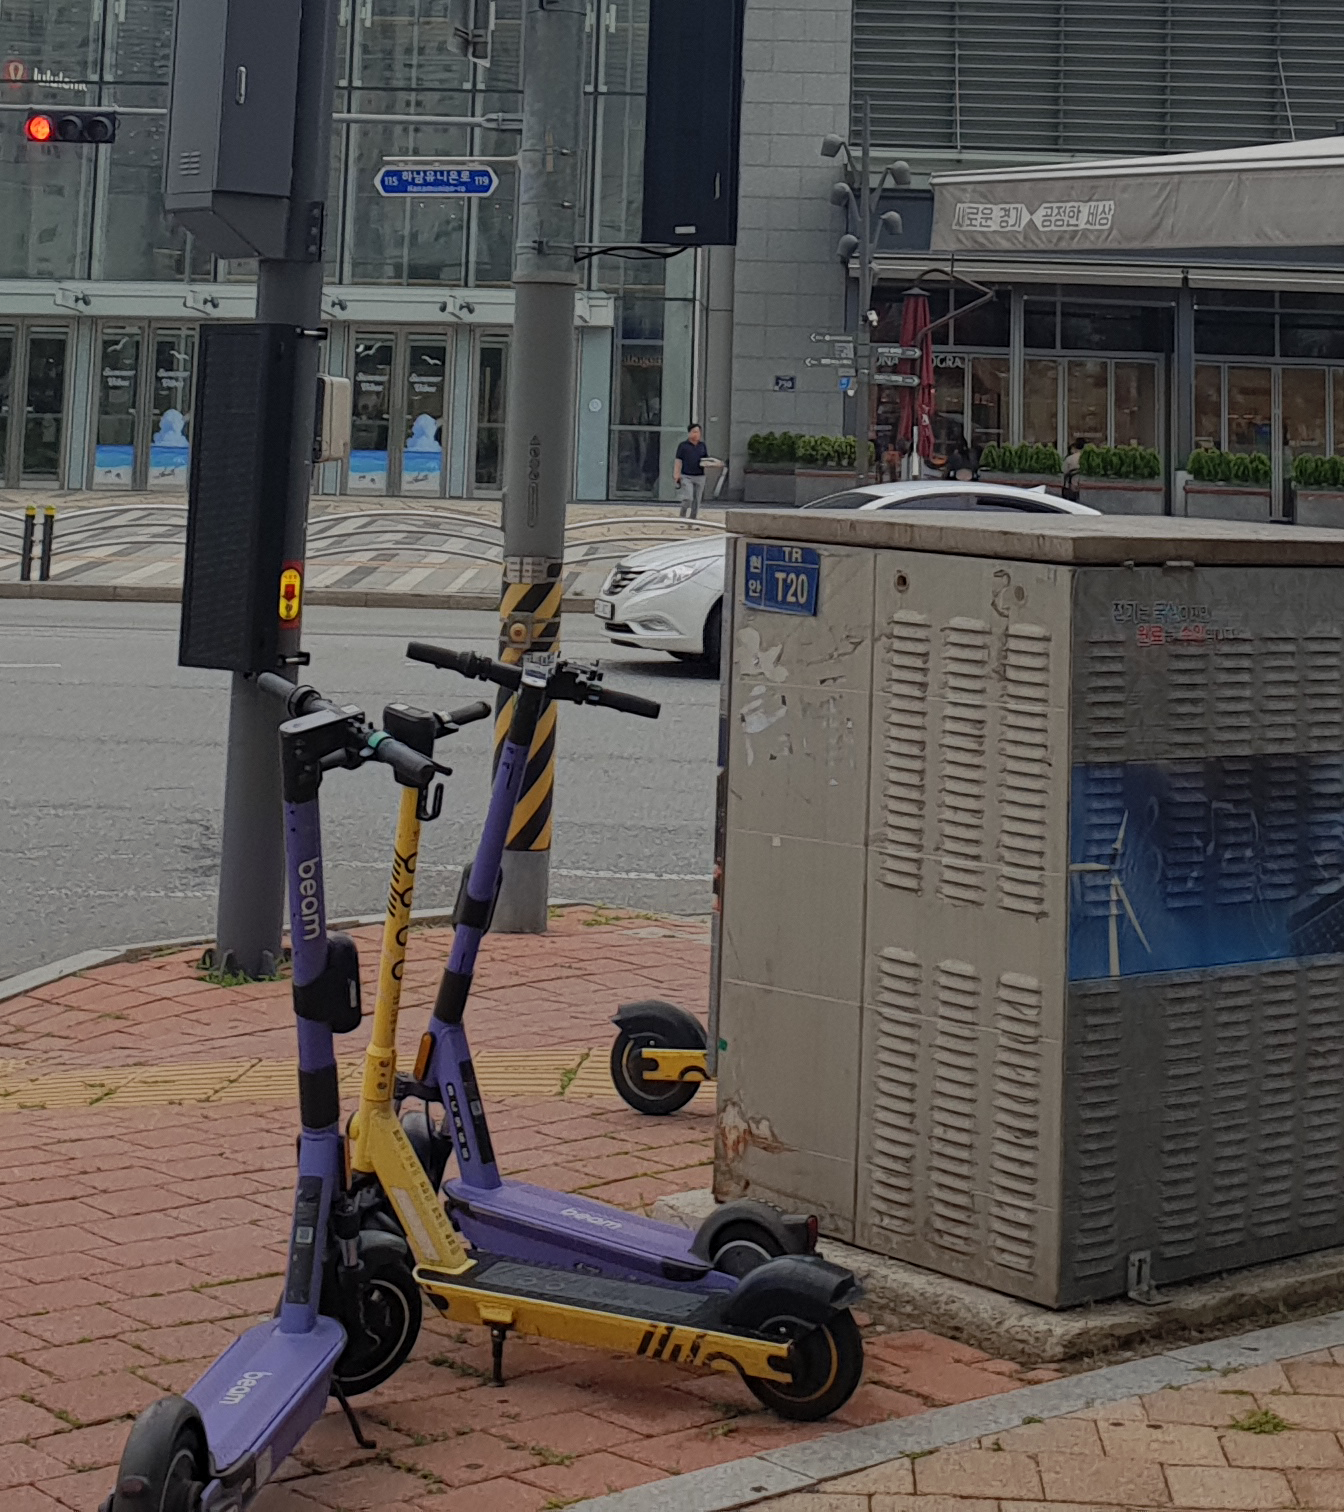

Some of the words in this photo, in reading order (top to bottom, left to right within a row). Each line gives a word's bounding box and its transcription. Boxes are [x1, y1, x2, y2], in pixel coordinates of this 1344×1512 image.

[401, 170, 471, 184] 하남유니온로
[957, 205, 994, 228] 새로운
[998, 206, 1023, 229] 경기
[1041, 205, 1082, 228] 공정한
[1084, 203, 1112, 227] 세상
[782, 546, 803, 563] TR
[774, 571, 809, 605] T20
[1136, 624, 1175, 647] 원료는
[298, 856, 321, 941] beam
[560, 1207, 623, 1230] beam
[218, 1371, 273, 1405] beam
